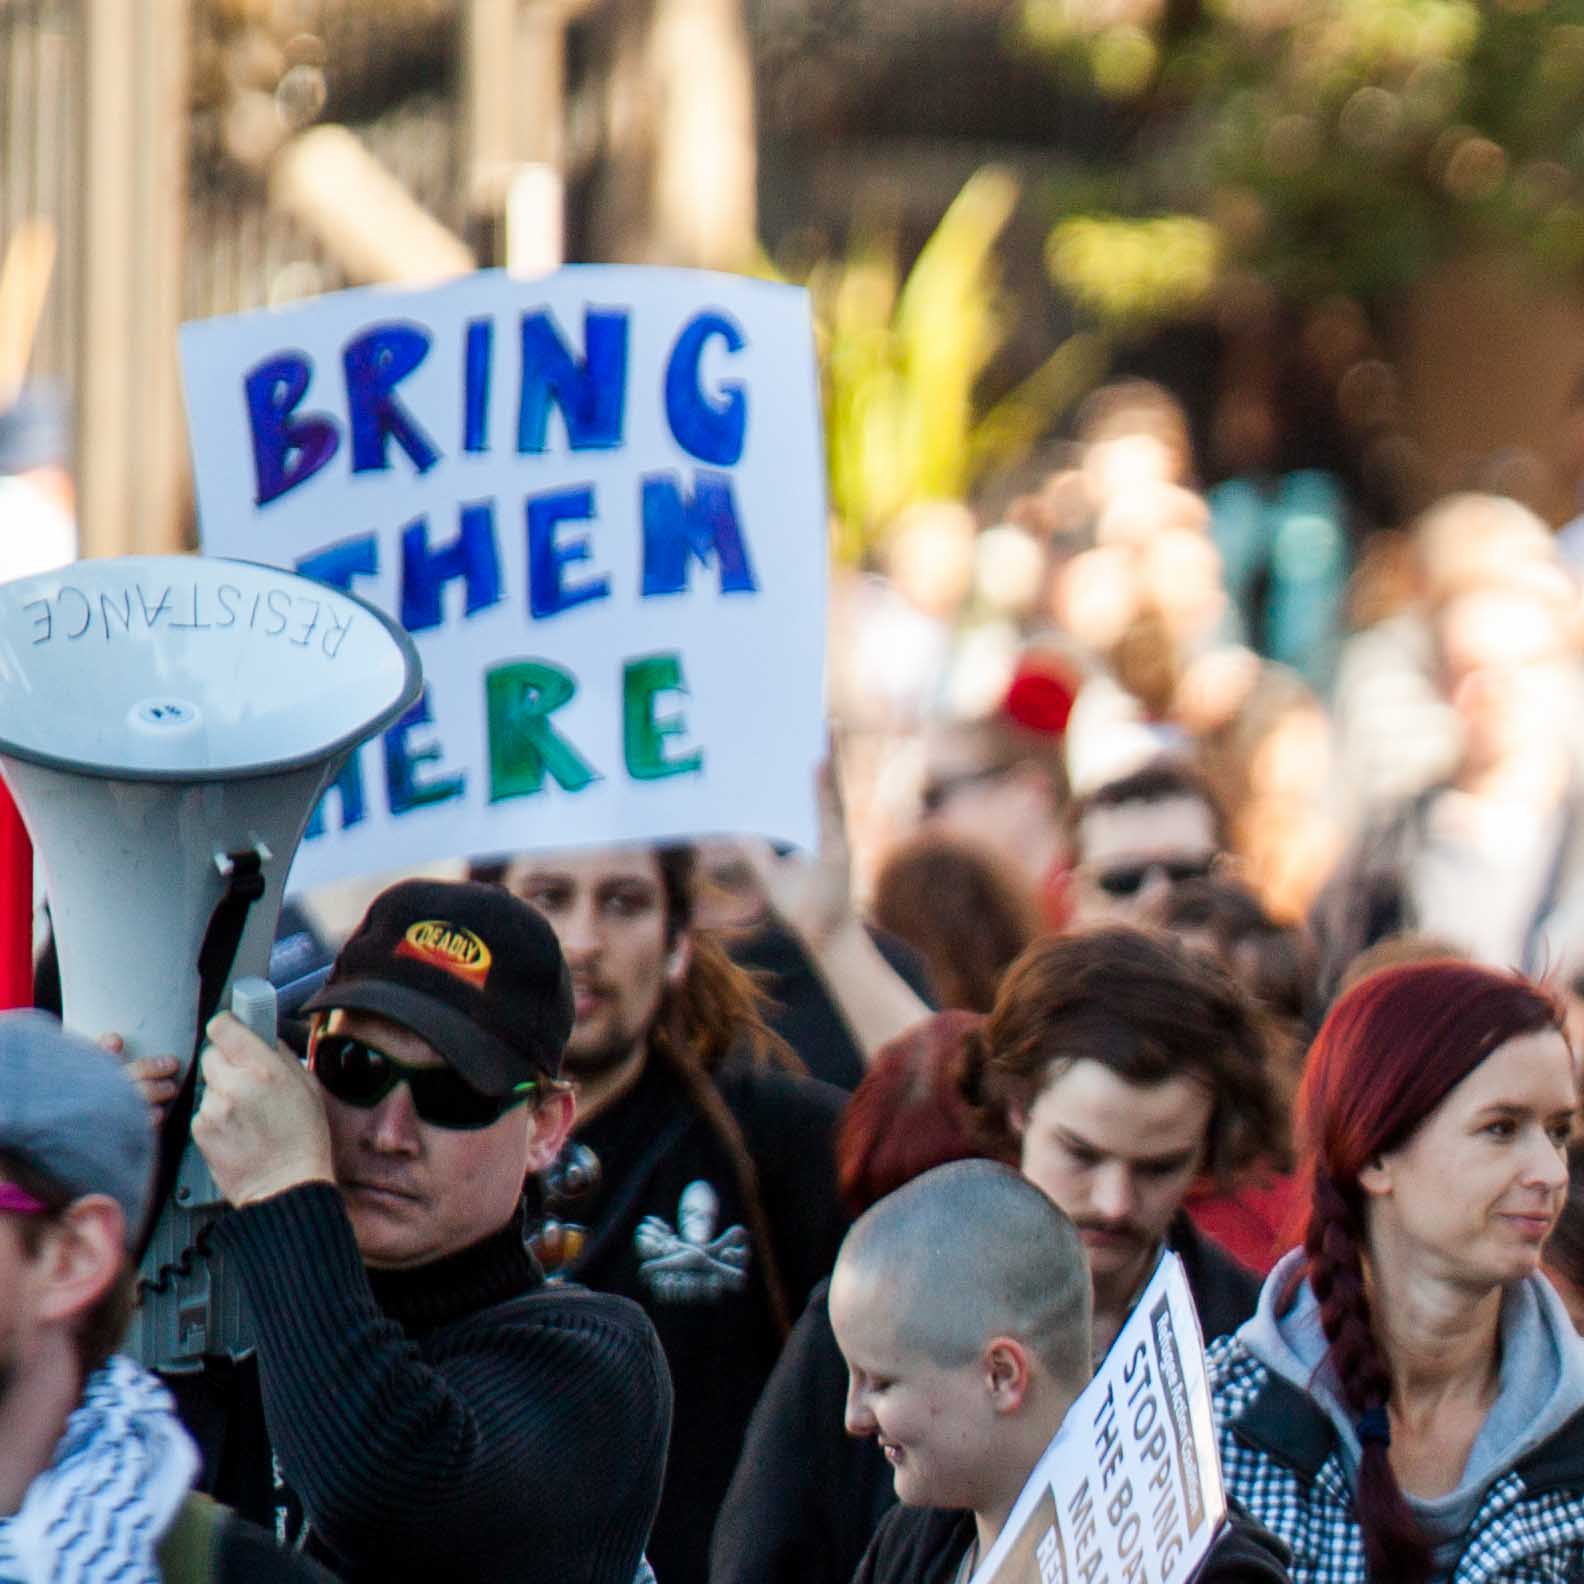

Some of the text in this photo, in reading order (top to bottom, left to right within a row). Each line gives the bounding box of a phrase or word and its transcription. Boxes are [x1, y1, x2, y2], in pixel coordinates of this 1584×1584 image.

[242, 303, 750, 508] BRING
[295, 468, 762, 634] THEM
[22, 582, 355, 659] RESISTANCE
[417, 925, 479, 964] DEADLY
[1093, 1381, 1123, 1492] THE
